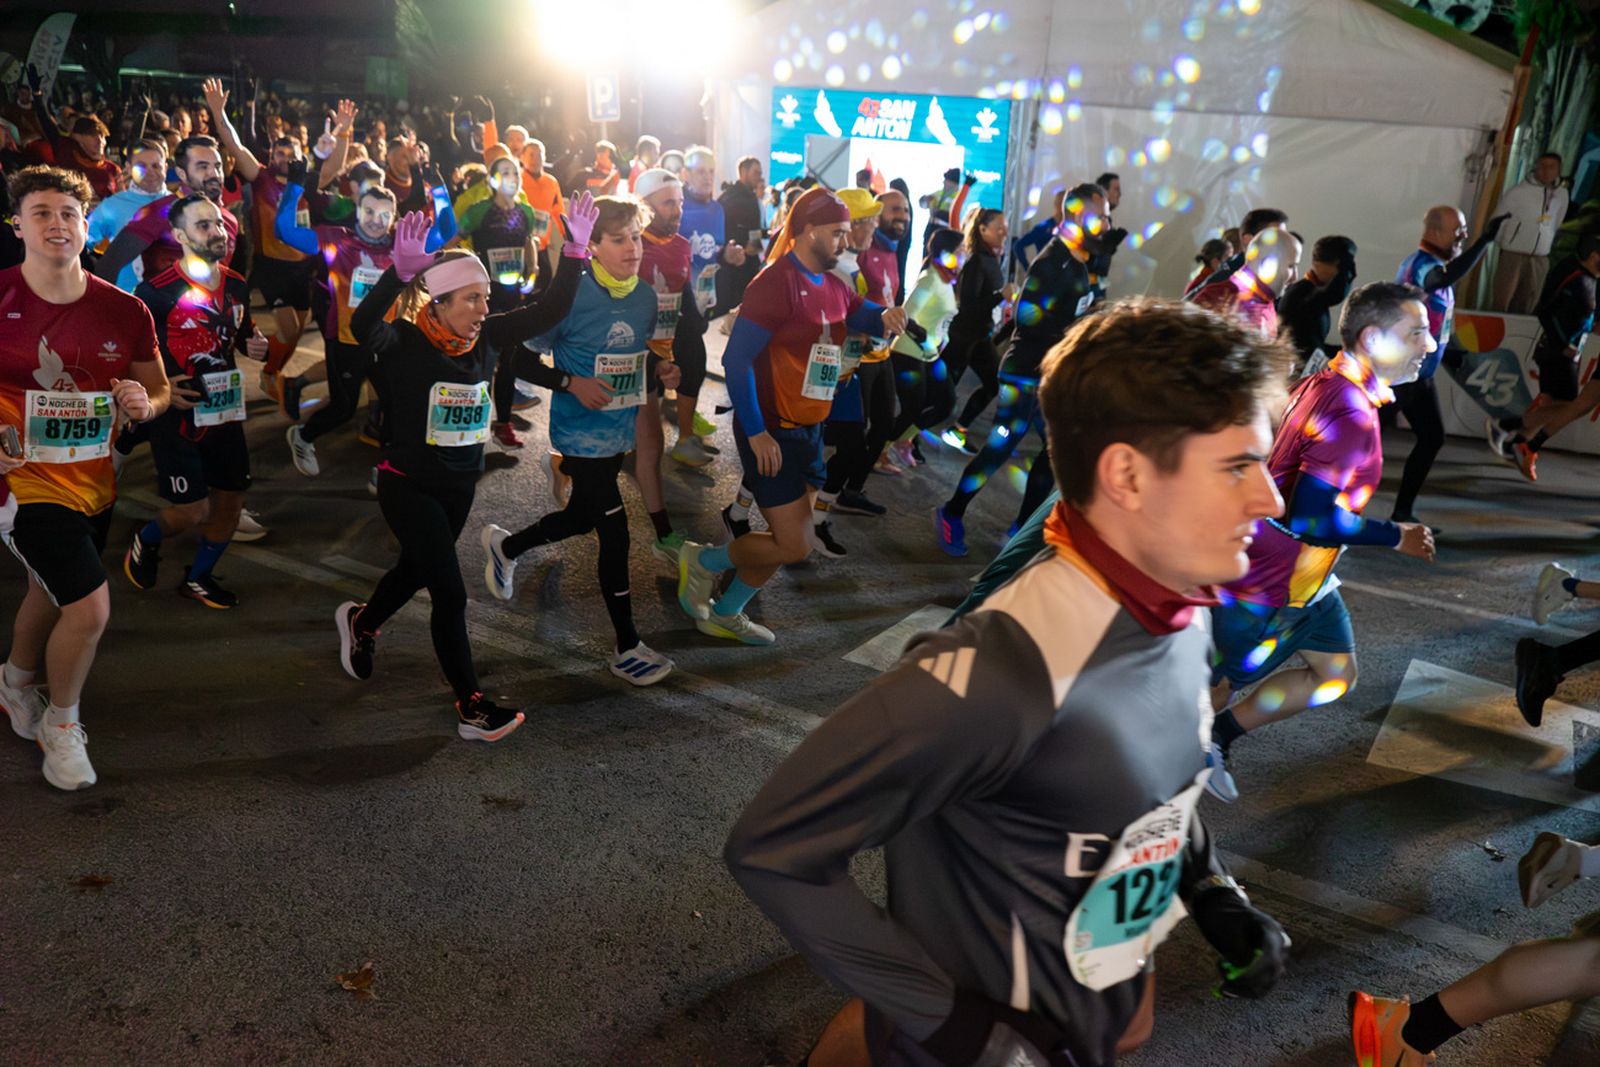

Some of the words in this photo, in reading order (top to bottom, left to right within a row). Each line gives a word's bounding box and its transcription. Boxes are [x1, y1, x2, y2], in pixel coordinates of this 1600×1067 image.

[595, 78, 613, 116] P
[879, 98, 917, 120] SAN
[1465, 358, 1520, 407] 43
[37, 408, 56, 416] SAN
[49, 400, 76, 408] NOCHE
[441, 406, 484, 425] 7938
[45, 418, 101, 440] 8759
[169, 476, 189, 494] 10
